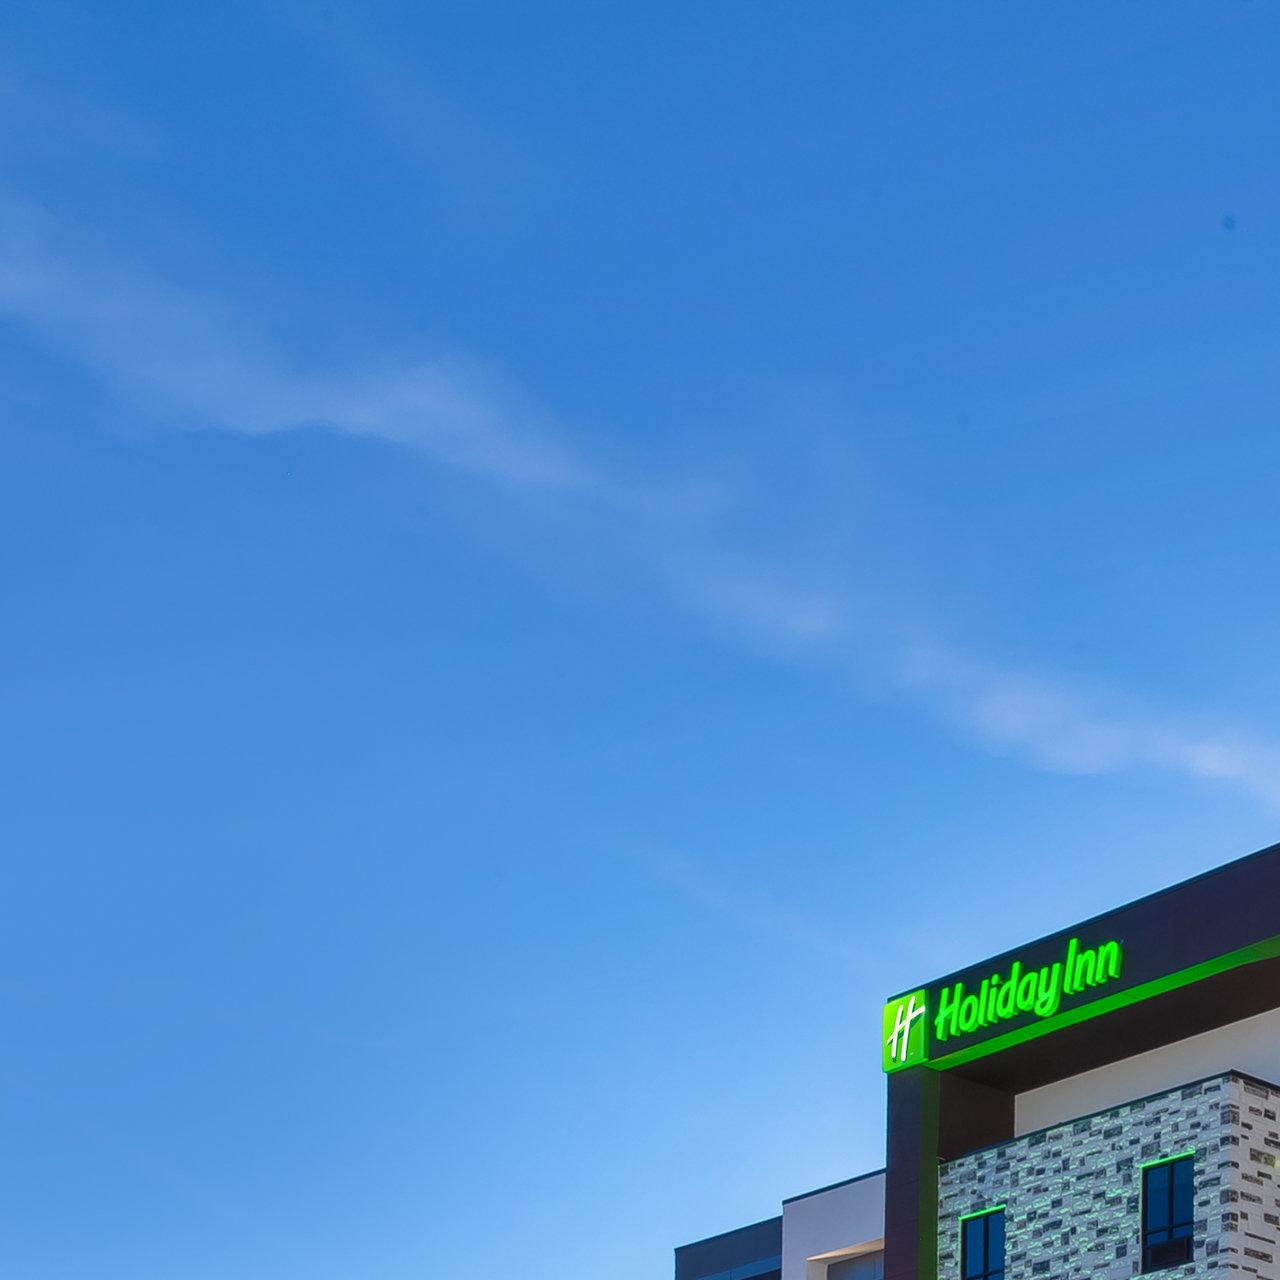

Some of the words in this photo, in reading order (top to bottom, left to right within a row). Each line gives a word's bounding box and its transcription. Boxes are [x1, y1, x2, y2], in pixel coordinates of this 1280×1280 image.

[886, 995, 925, 1062] H
[934, 961, 1063, 1041] Holiday
[1063, 937, 1122, 995] Inn
